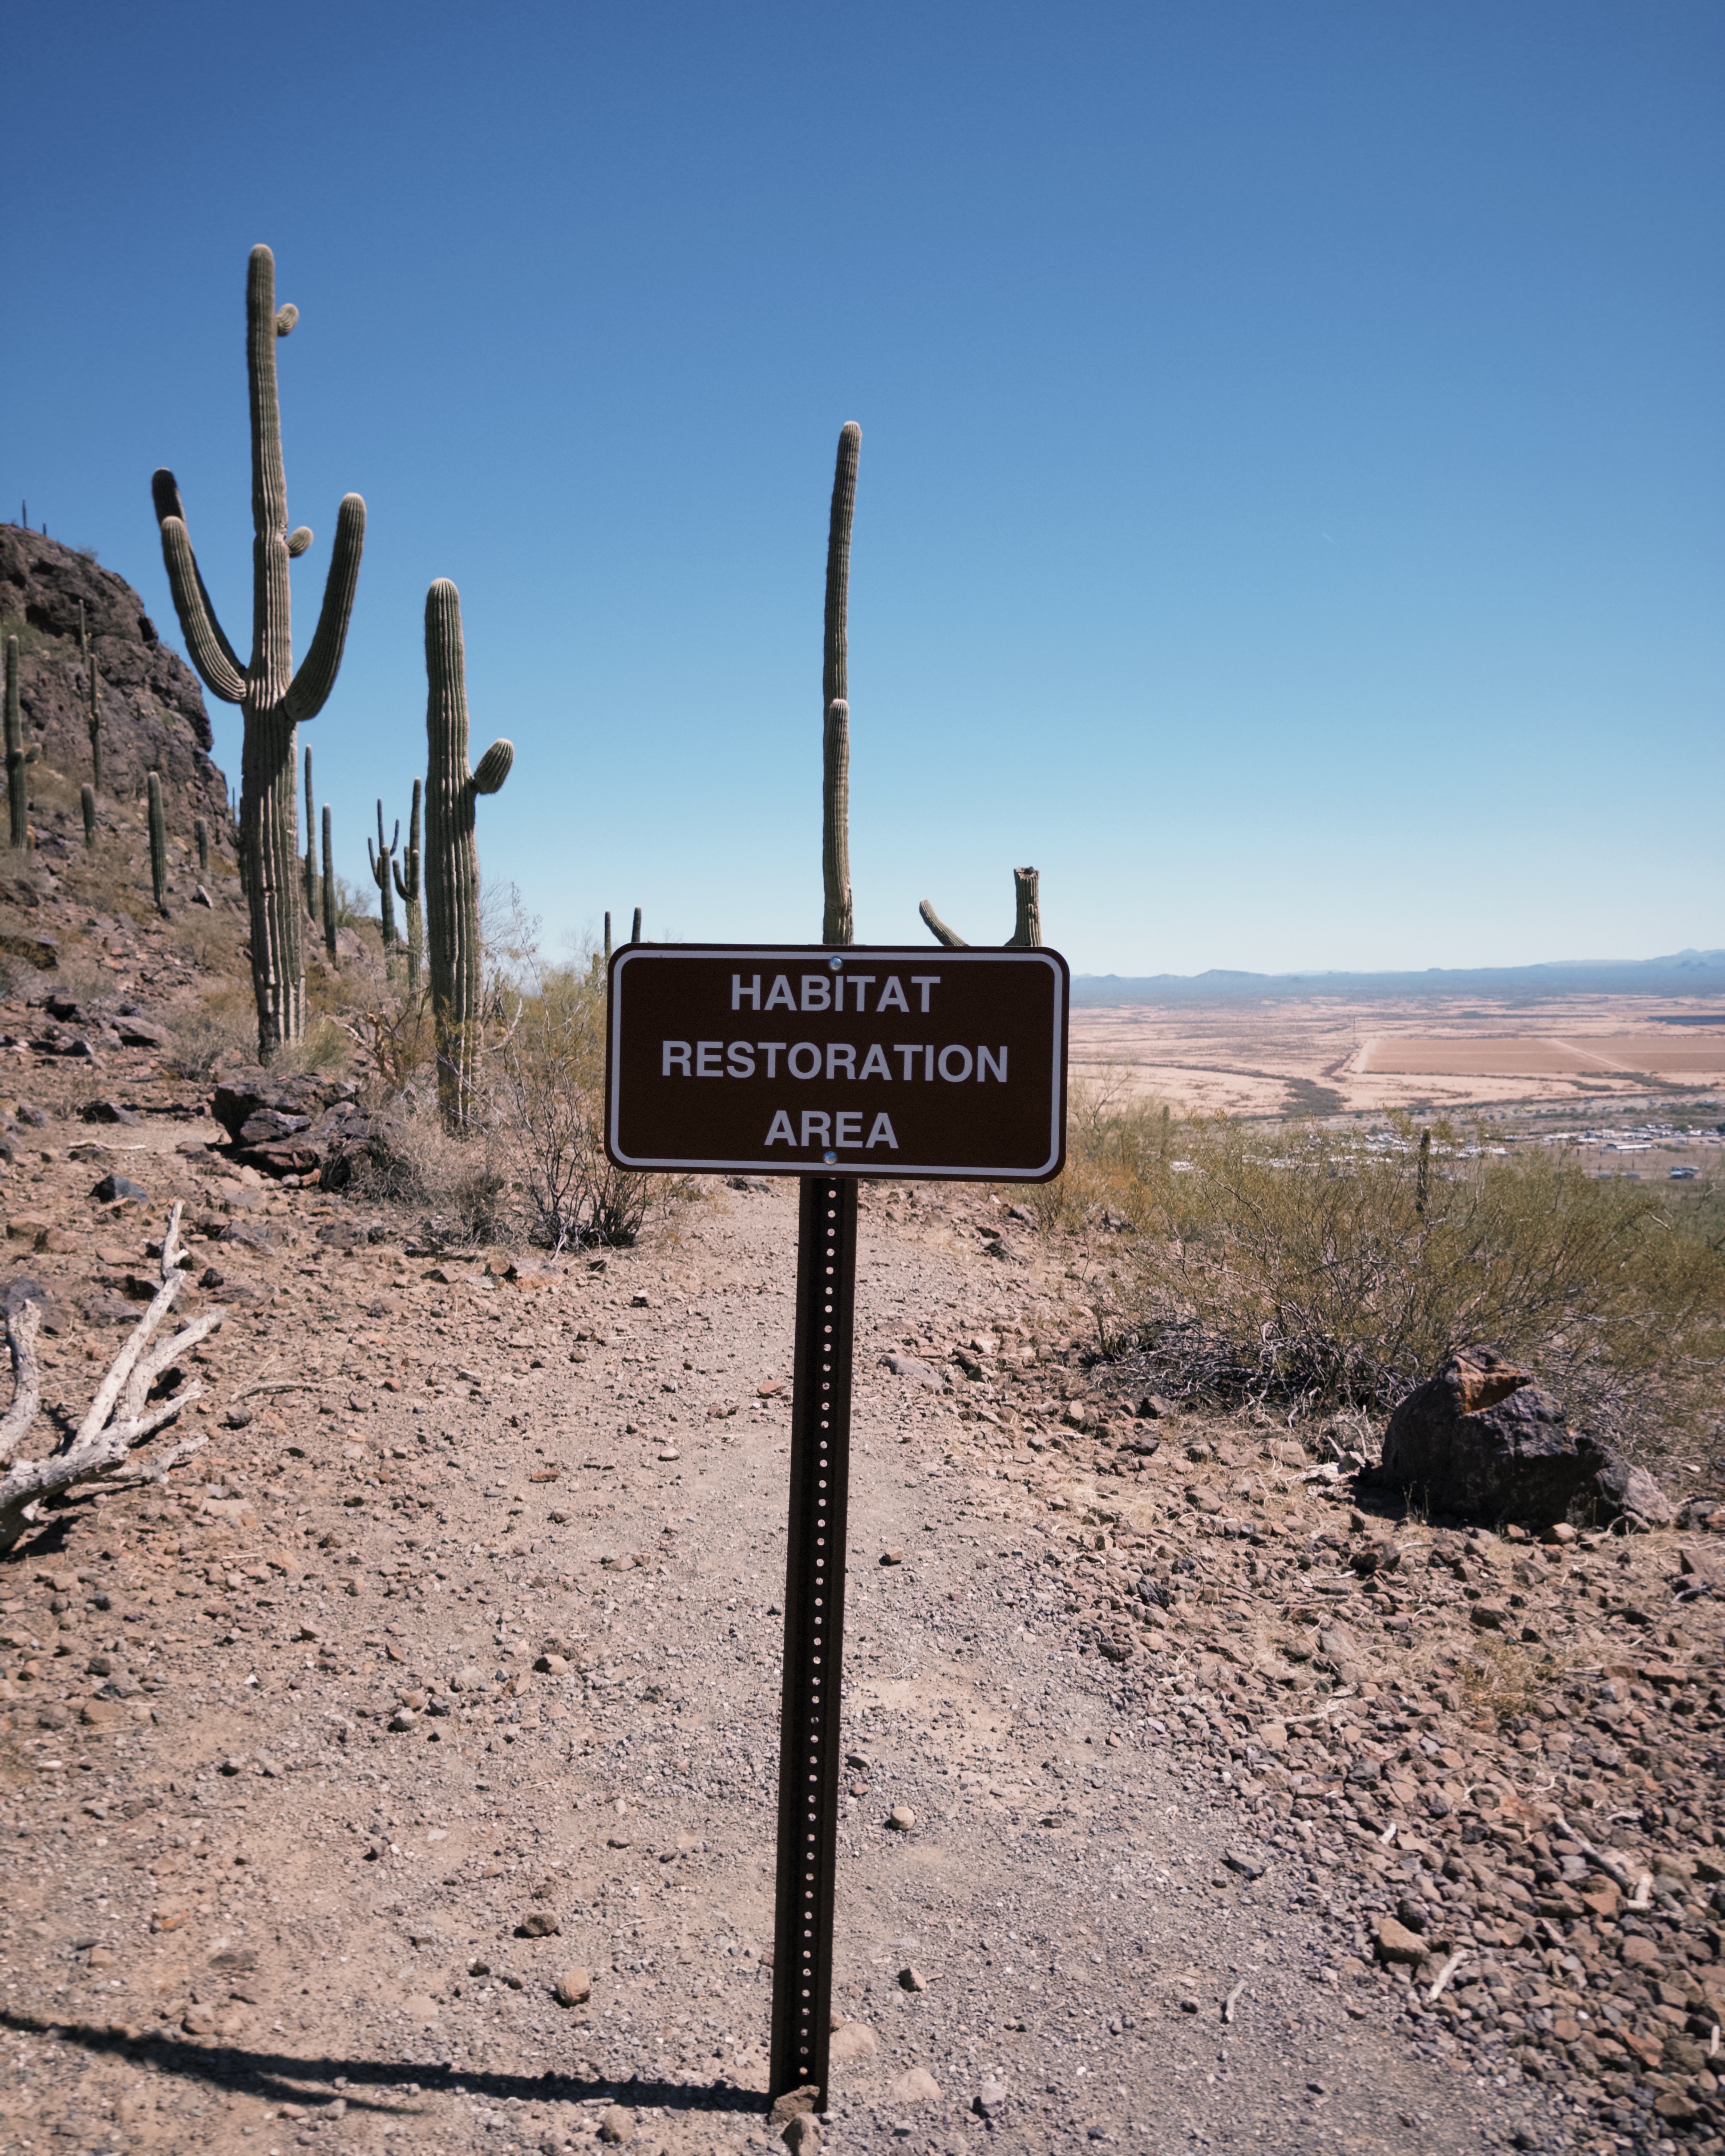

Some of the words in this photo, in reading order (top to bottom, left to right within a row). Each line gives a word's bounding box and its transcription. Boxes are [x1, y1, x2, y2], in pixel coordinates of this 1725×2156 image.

[732, 974, 941, 1012] HABITAT
[662, 1040, 1008, 1083] RESTORATION
[764, 1110, 899, 1149] AREA
